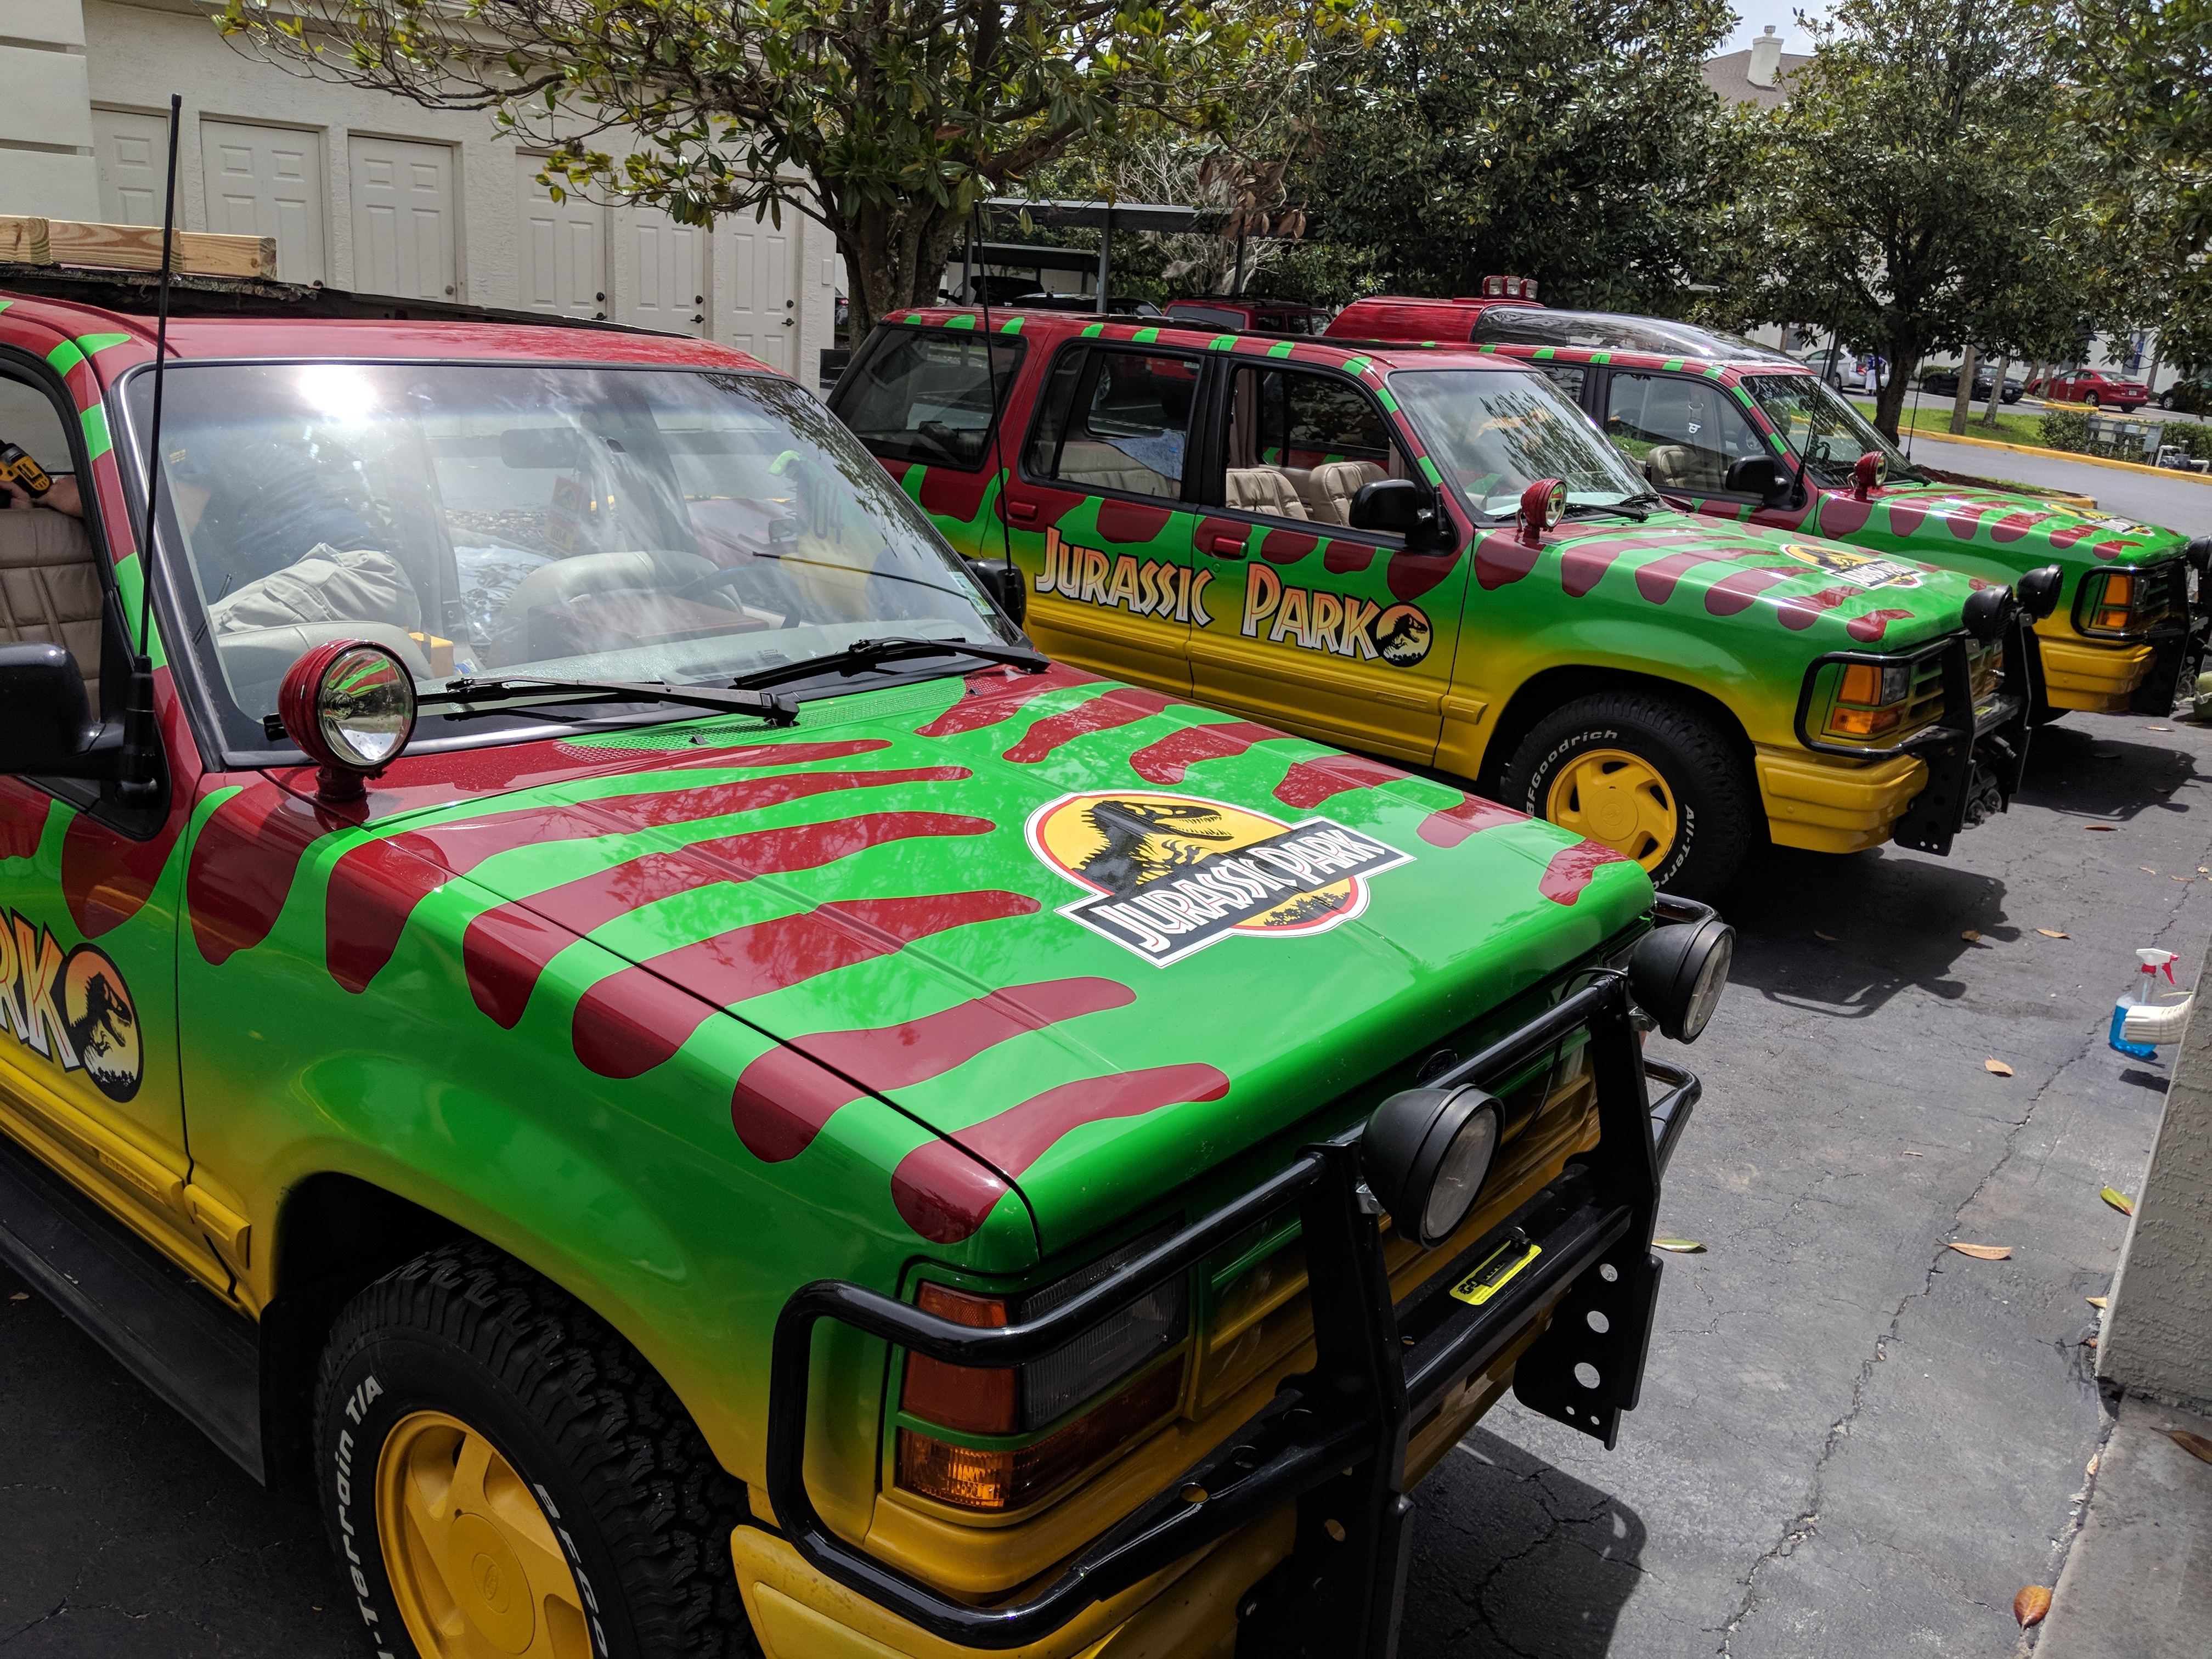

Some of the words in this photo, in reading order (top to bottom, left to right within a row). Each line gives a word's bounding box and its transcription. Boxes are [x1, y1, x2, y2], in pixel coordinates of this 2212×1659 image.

[1035, 525, 1215, 628] JURASSIC
[1240, 561, 1383, 661] PARK
[1526, 730, 1618, 816] BFGoodrich
[1088, 857, 1298, 953] JURASSIC
[1245, 830, 1386, 885] PARK
[345, 1375, 384, 1425] T/A
